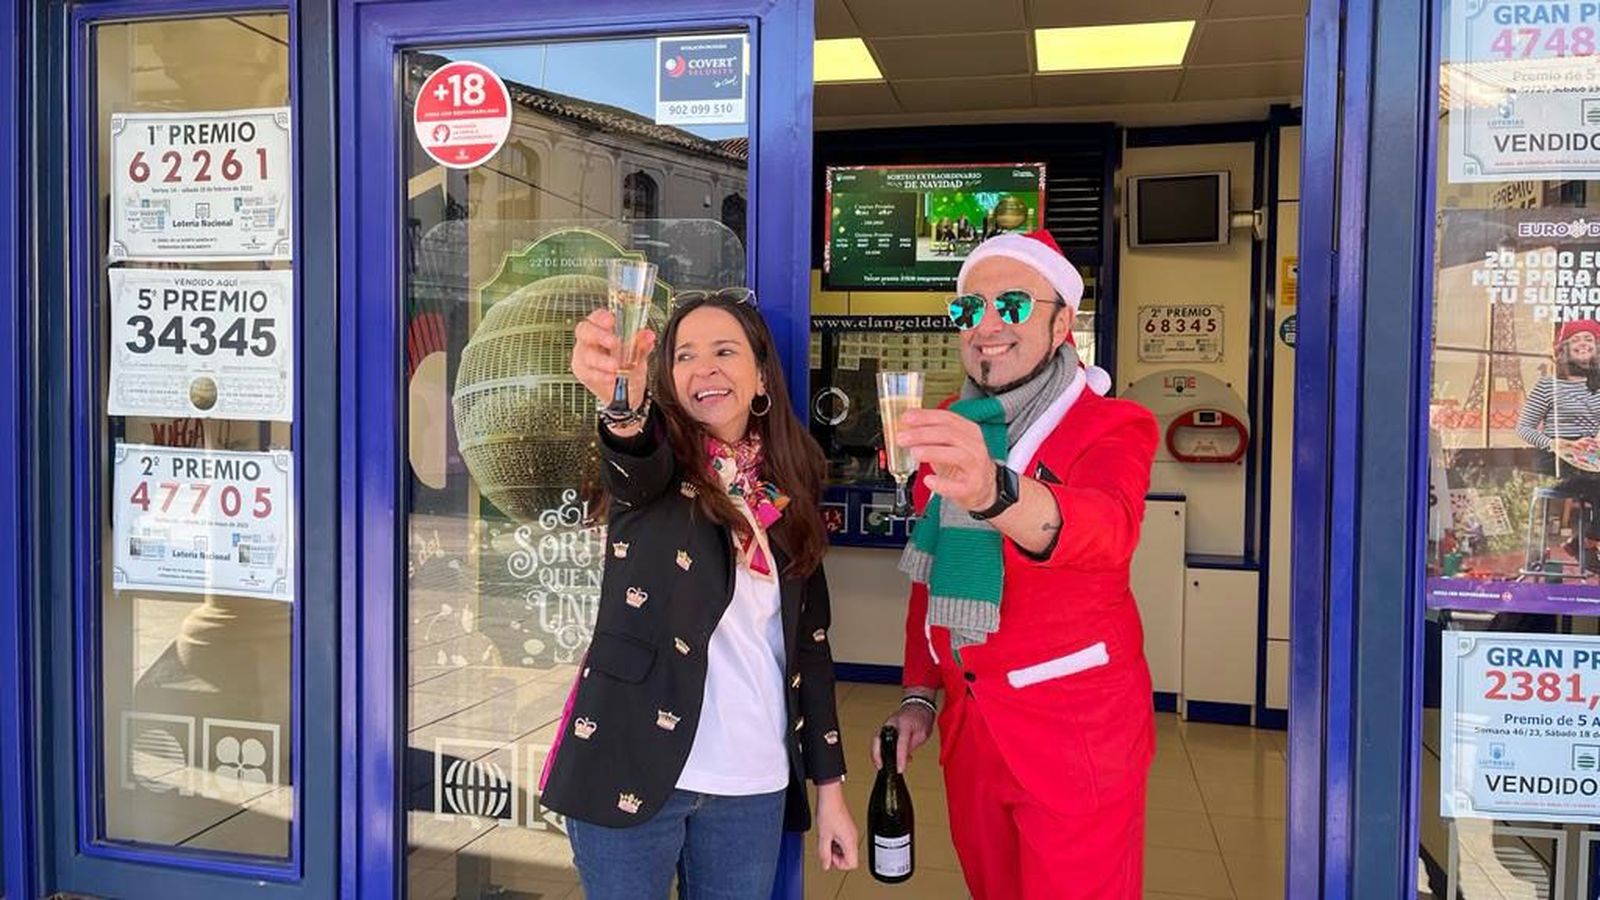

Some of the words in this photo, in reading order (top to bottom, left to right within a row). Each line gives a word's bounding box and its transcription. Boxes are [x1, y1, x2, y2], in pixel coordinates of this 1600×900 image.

[1493, 3, 1569, 25] GRAN
[1580, 3, 1600, 23] P
[688, 58, 734, 69] COVERT
[433, 73, 486, 107] +18
[668, 105, 688, 115] 902
[691, 104, 711, 114] 099
[714, 103, 733, 114] 510
[170, 121, 256, 145] PREMIO
[128, 147, 268, 183] 62261
[919, 180, 963, 188] NAVIDAD
[1518, 222, 1569, 237] EURO
[174, 278, 215, 286] VENDIDO
[1472, 269, 1520, 286] MES
[1526, 269, 1591, 287] PARA
[163, 289, 268, 312] PREMIO
[1487, 287, 1518, 304] TU
[1167, 307, 1212, 317] PREMIO
[126, 315, 277, 357] 34345
[1145, 318, 1217, 333] 68345
[172, 457, 261, 481] PREMIO
[130, 481, 273, 519] 47705
[539, 568, 585, 593] QUE
[1486, 647, 1563, 668] GRAN
[1504, 713, 1553, 726] Premio
[1557, 715, 1573, 726] de
[1578, 714, 1588, 727] 5
[1485, 774, 1598, 796] VENDIDO
